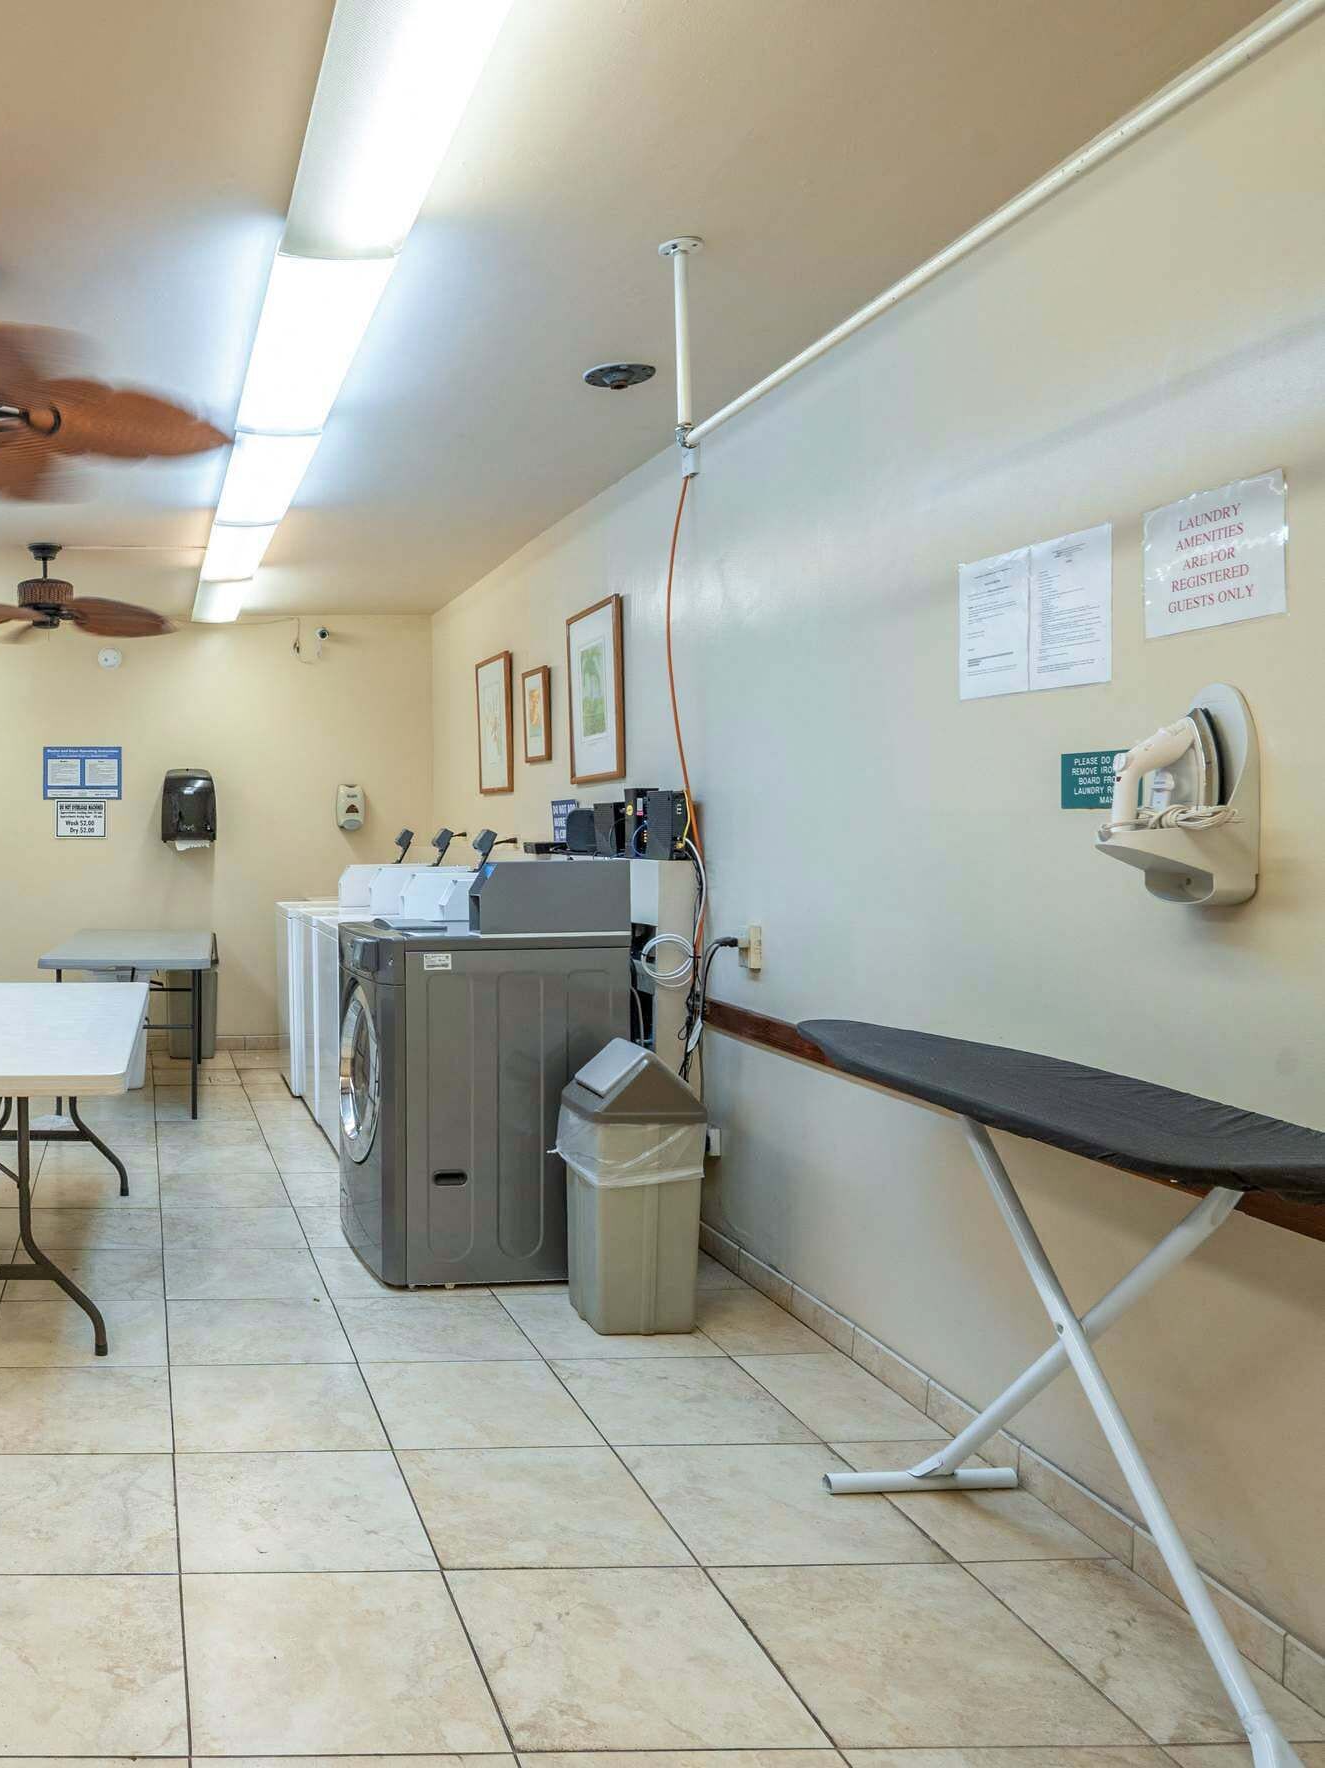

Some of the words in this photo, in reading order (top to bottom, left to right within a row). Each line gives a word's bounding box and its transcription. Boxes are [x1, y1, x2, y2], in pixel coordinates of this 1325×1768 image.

[1179, 503, 1241, 532] LAUNDRY
[1176, 522, 1244, 551] AMENITIES
[1183, 554, 1208, 570] ARE
[1211, 547, 1235, 563] FOR
[1171, 564, 1249, 592] REGISTERED
[1168, 592, 1215, 614] GUESTS
[1218, 584, 1254, 603] ONLY
[1071, 767, 1098, 776] REMOVE
[1074, 757, 1098, 766] PLEASE
[1101, 756, 1111, 764] DO
[1074, 786, 1104, 795] LAUNDRY
[1078, 777, 1100, 785] BOARD
